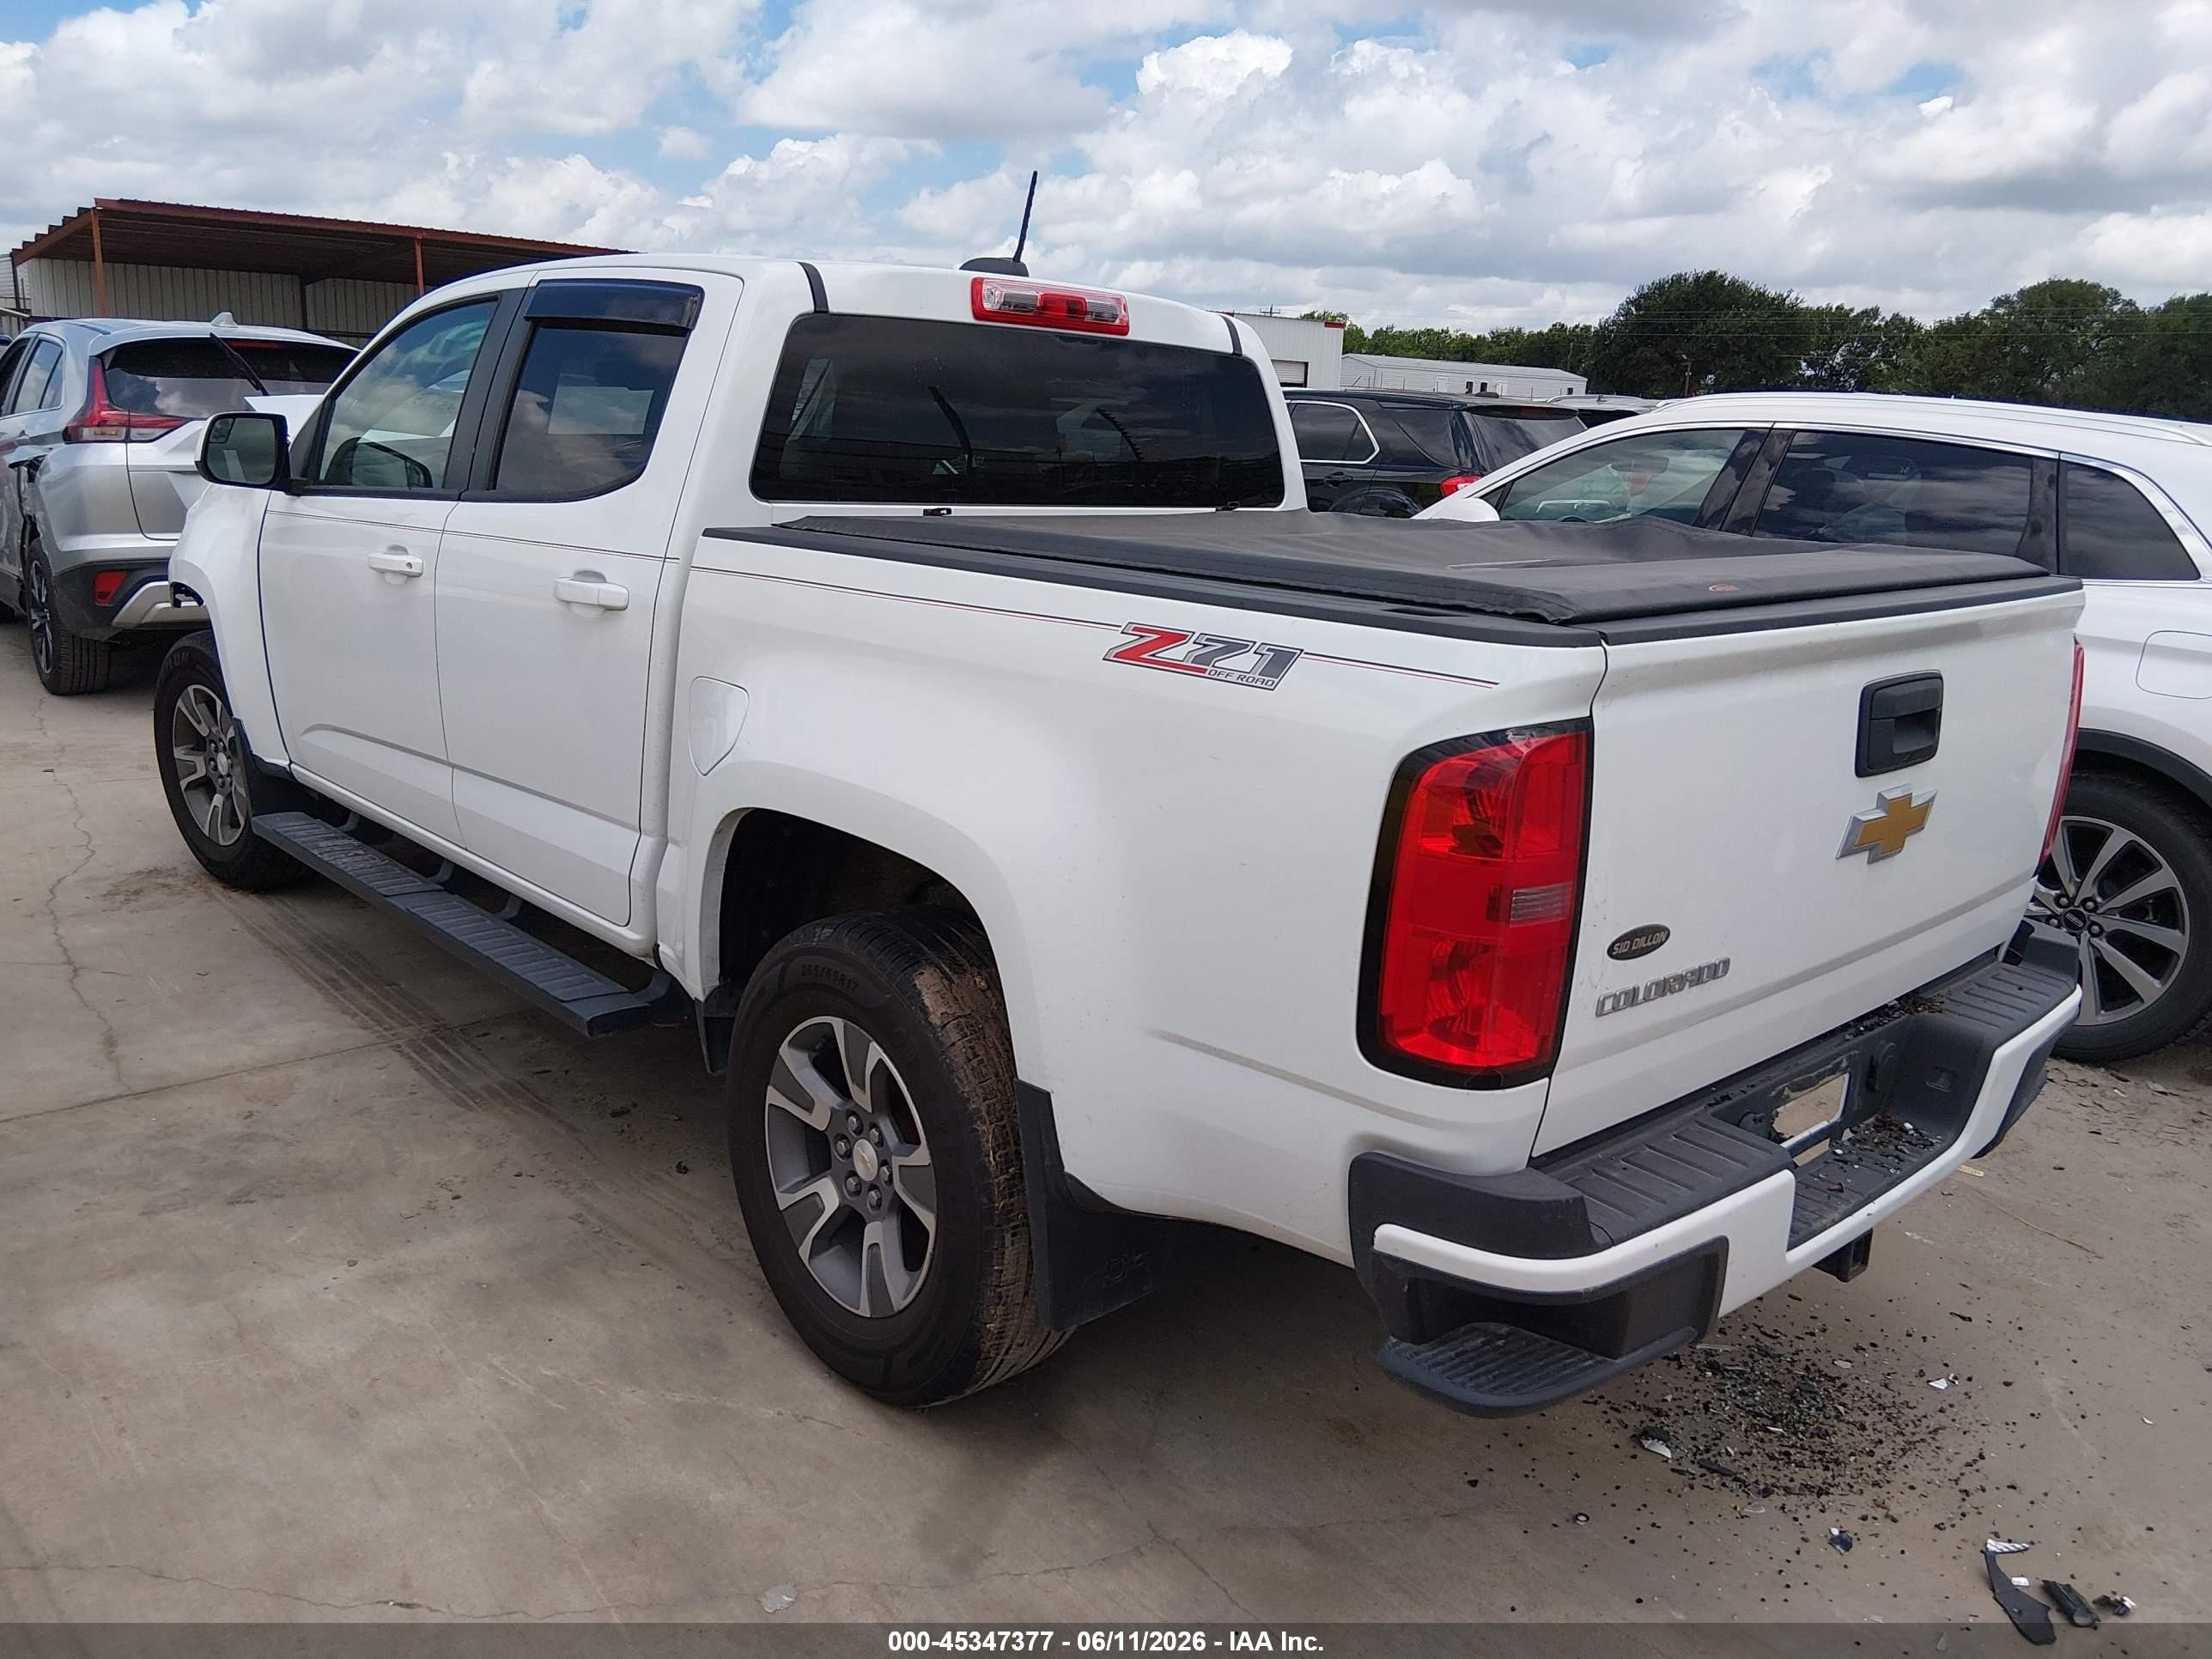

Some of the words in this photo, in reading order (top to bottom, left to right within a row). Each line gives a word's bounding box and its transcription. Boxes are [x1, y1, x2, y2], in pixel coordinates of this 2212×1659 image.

[1103, 622, 1304, 686] Z71
[1207, 669, 1235, 681] OFF
[1236, 674, 1276, 687] ROAD
[1612, 940, 1631, 956] SID
[1632, 930, 1669, 951] DILLON
[1595, 957, 1730, 1018] COLORADO
